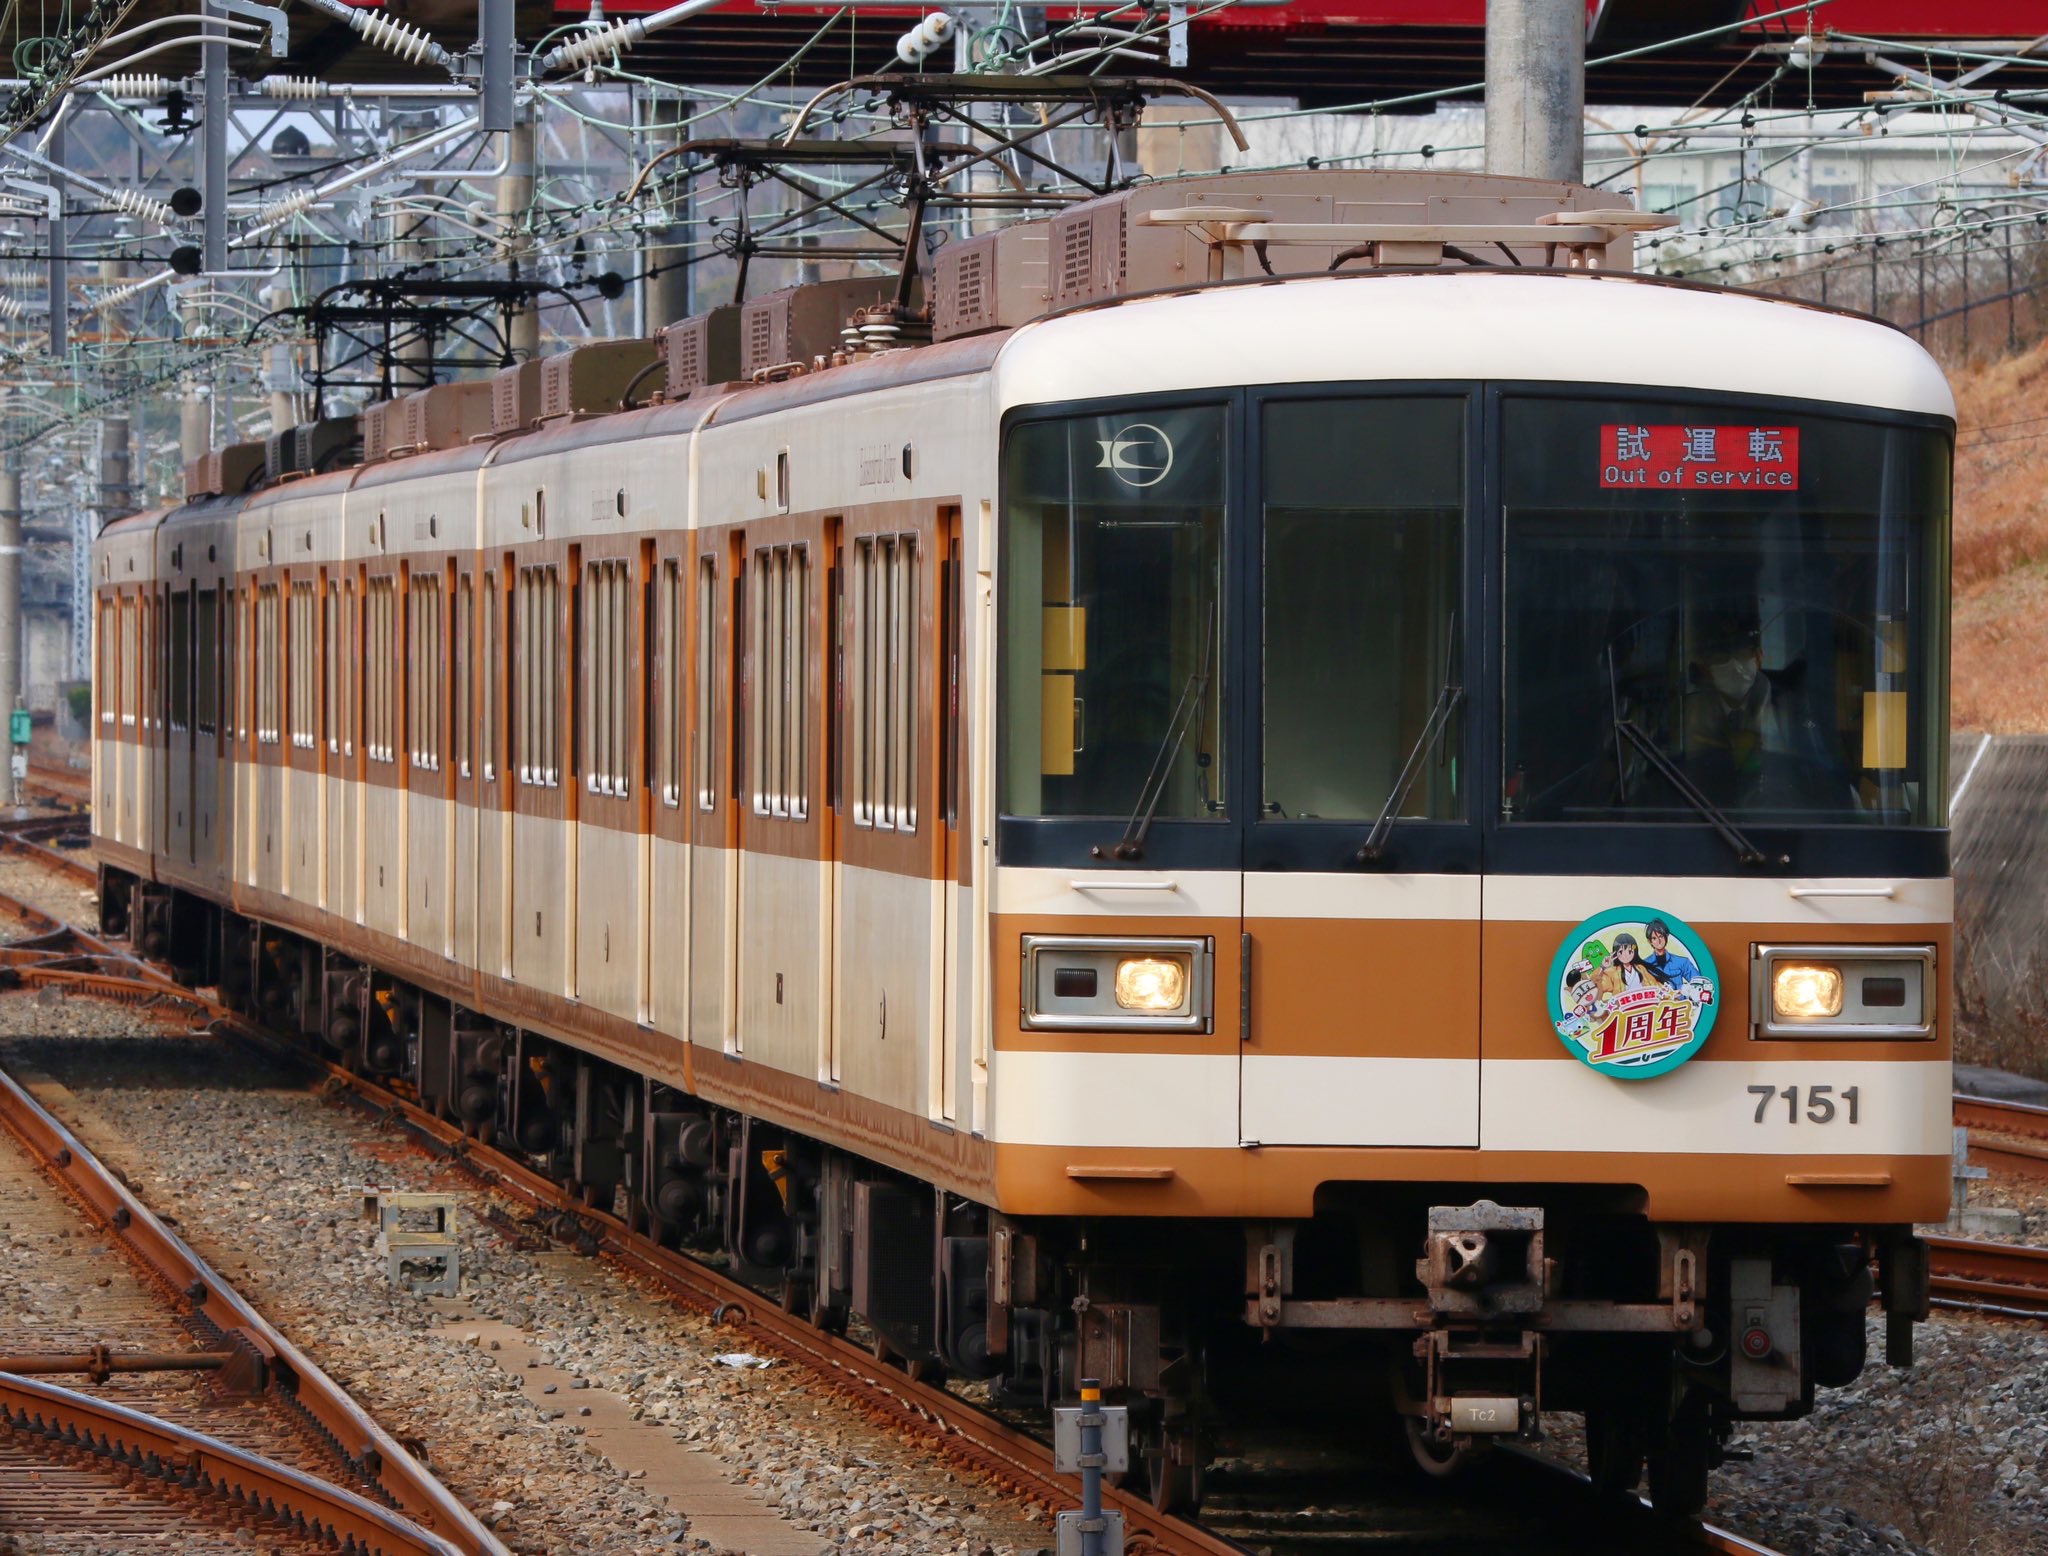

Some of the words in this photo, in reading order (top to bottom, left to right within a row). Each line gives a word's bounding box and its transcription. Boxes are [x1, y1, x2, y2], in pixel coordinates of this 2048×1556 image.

[1605, 466, 1647, 484] Out
[1658, 466, 1684, 484] of
[1695, 467, 1793, 485] service
[1595, 1005, 1688, 1057] 1周年
[1747, 1085, 1858, 1124] 7151
[1468, 1408, 1497, 1421] Tc2
